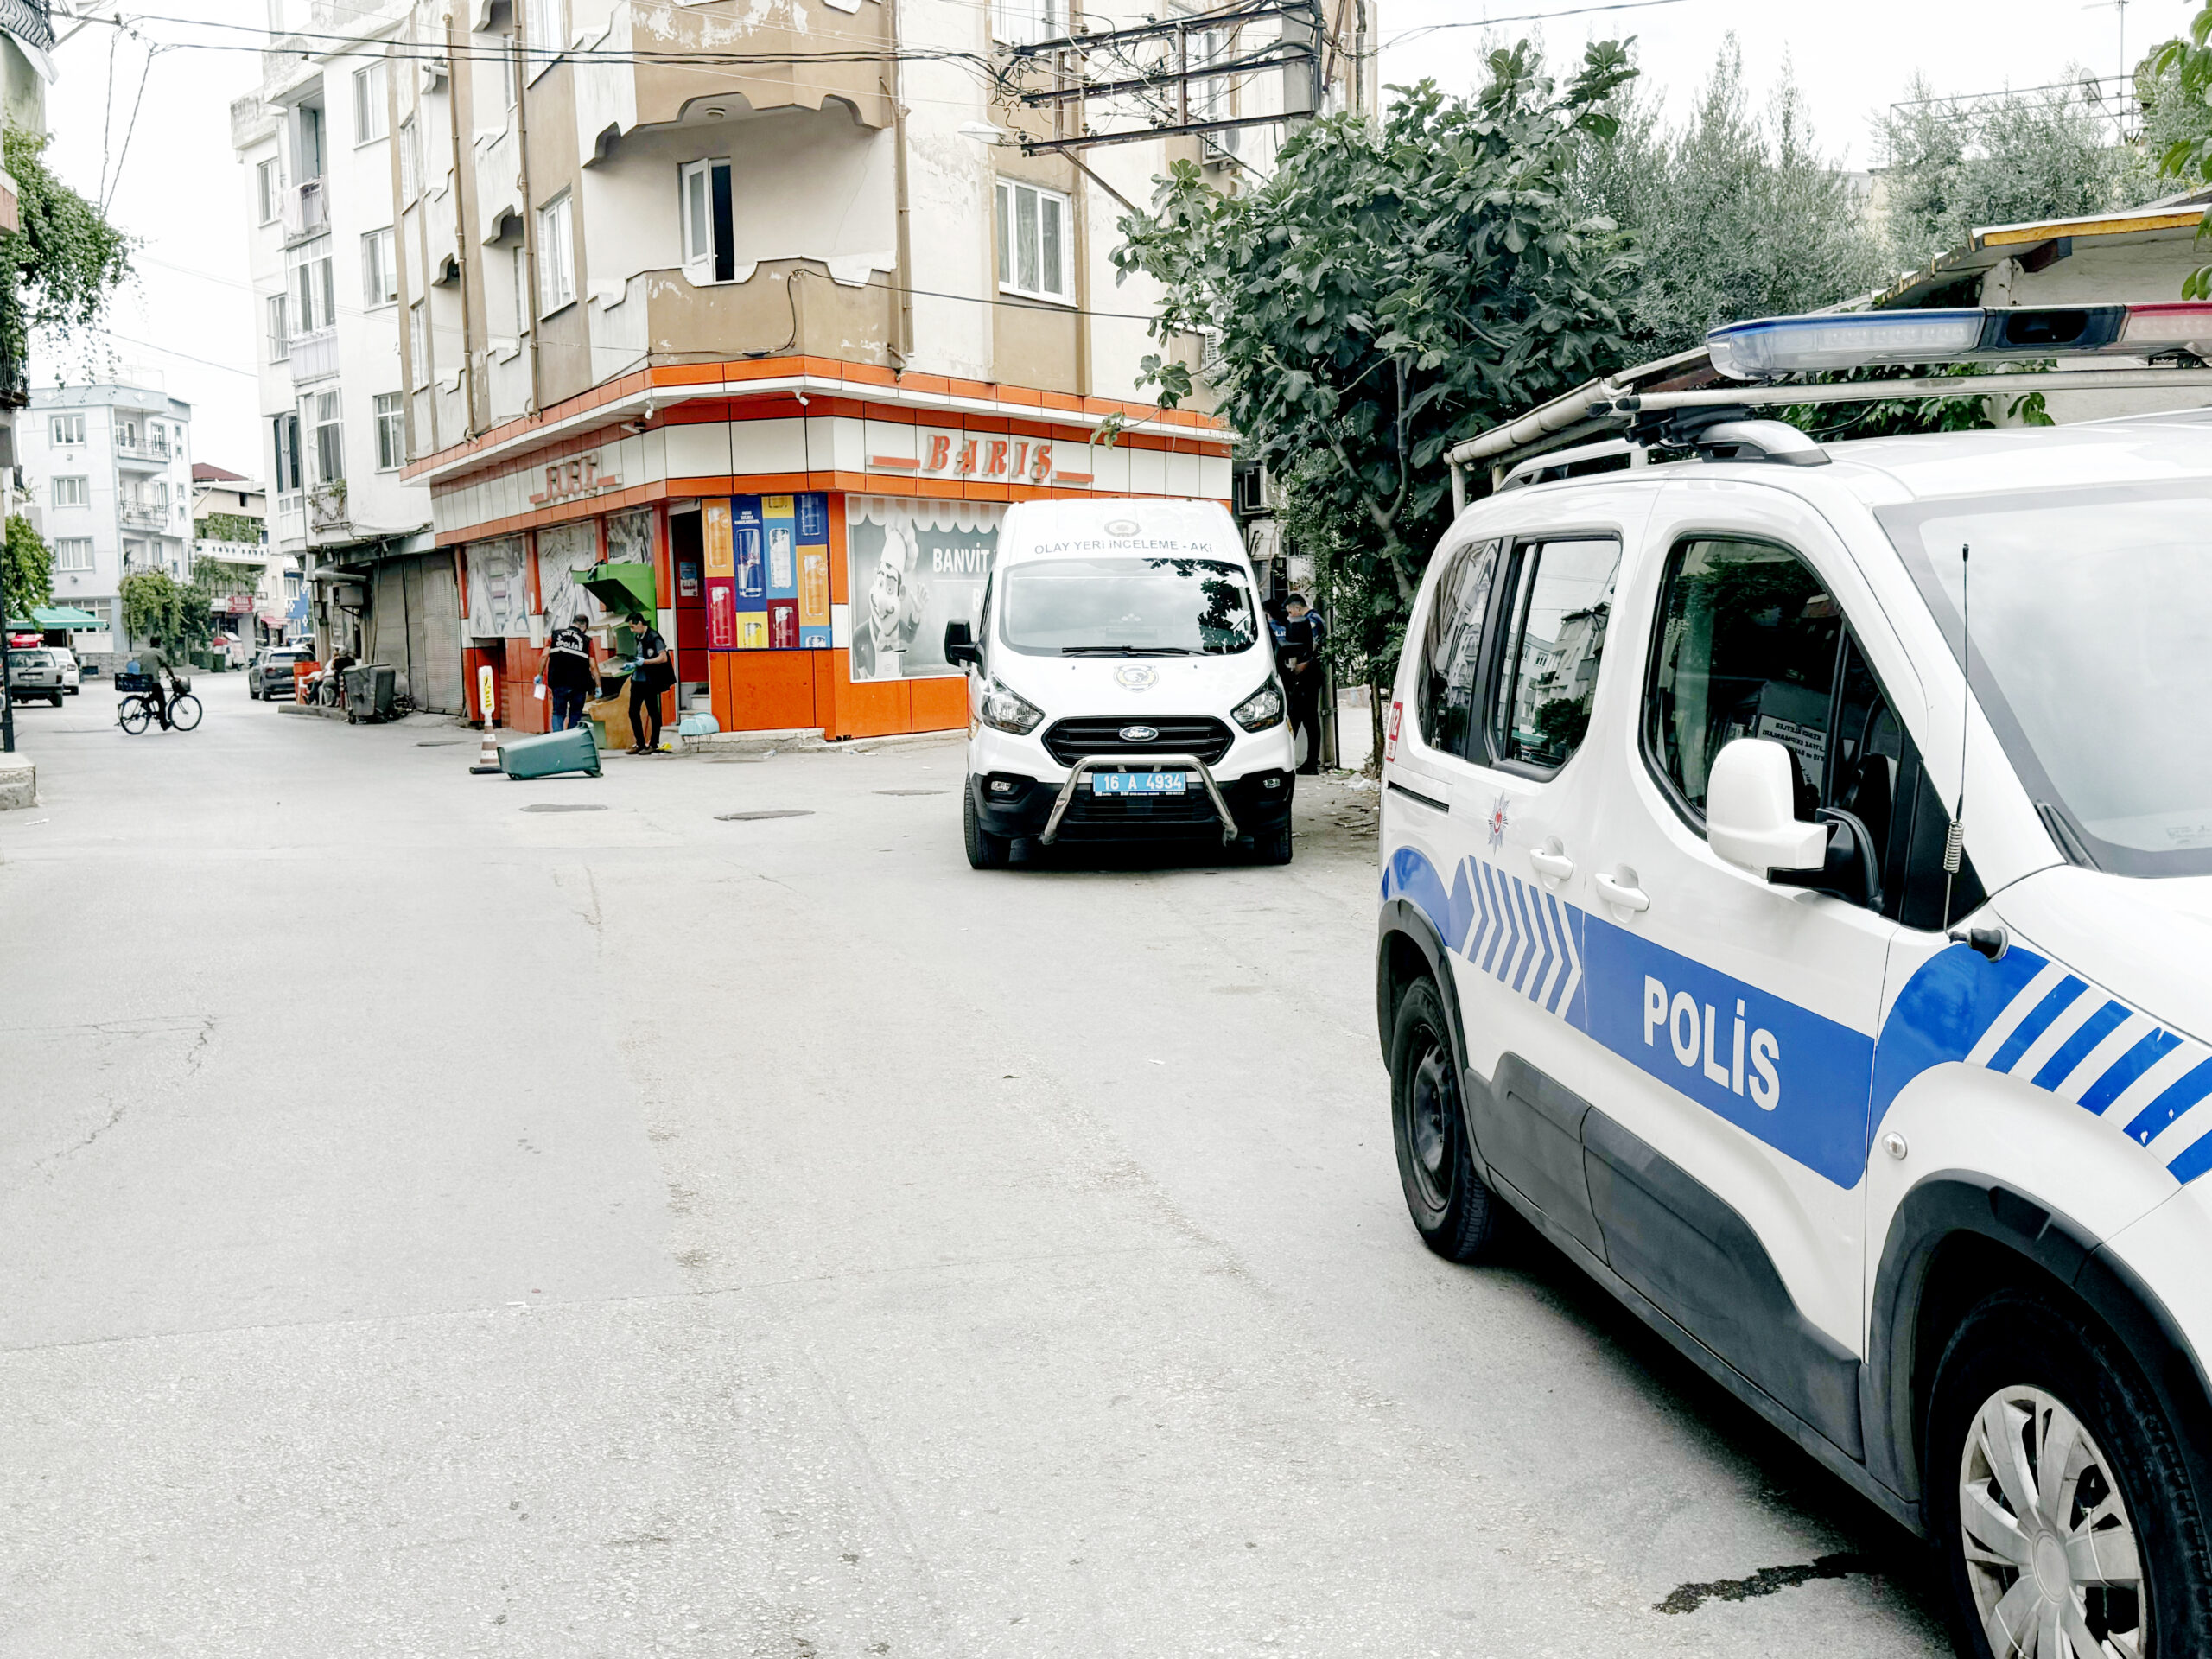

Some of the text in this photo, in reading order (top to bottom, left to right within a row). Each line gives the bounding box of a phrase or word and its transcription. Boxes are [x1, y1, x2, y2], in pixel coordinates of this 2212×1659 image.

[1034, 541, 1070, 555] OLAY
[1103, 773, 1182, 790] 16 A 4934
[1644, 974, 1780, 1111] POLİS
